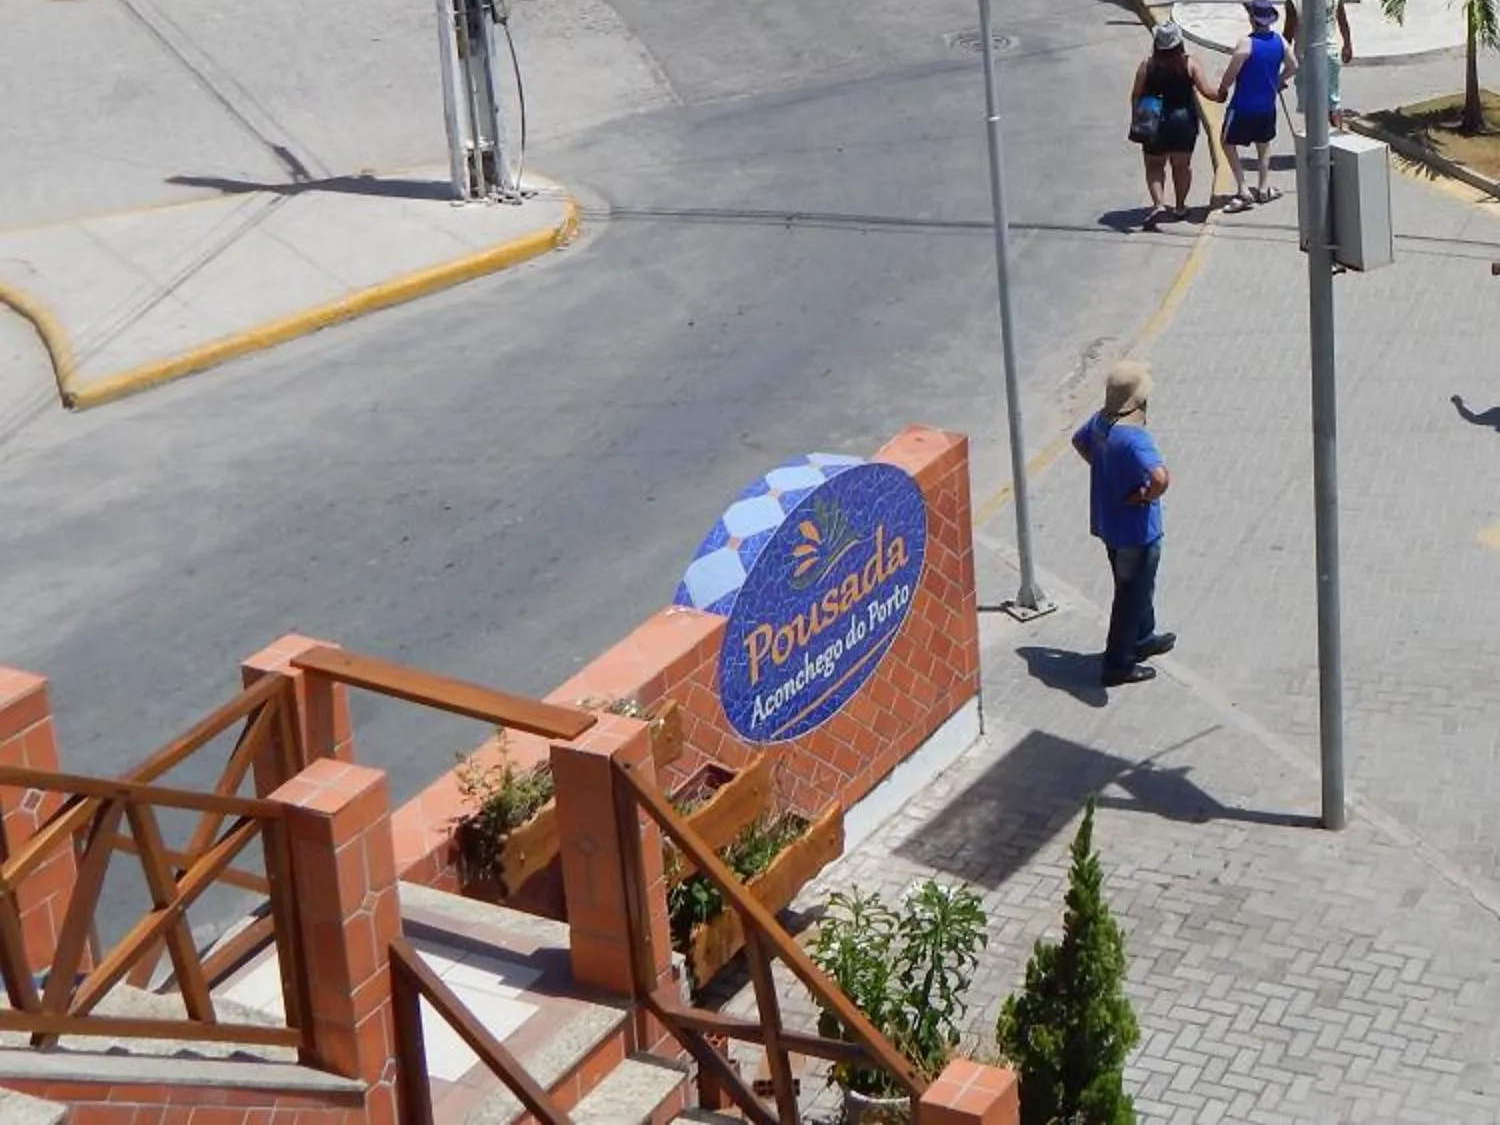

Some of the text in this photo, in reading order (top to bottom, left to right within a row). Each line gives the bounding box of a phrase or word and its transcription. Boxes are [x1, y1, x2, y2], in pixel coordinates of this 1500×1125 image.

[743, 525, 910, 687] Pousada
[750, 583, 911, 730] Aconchego do Porto
